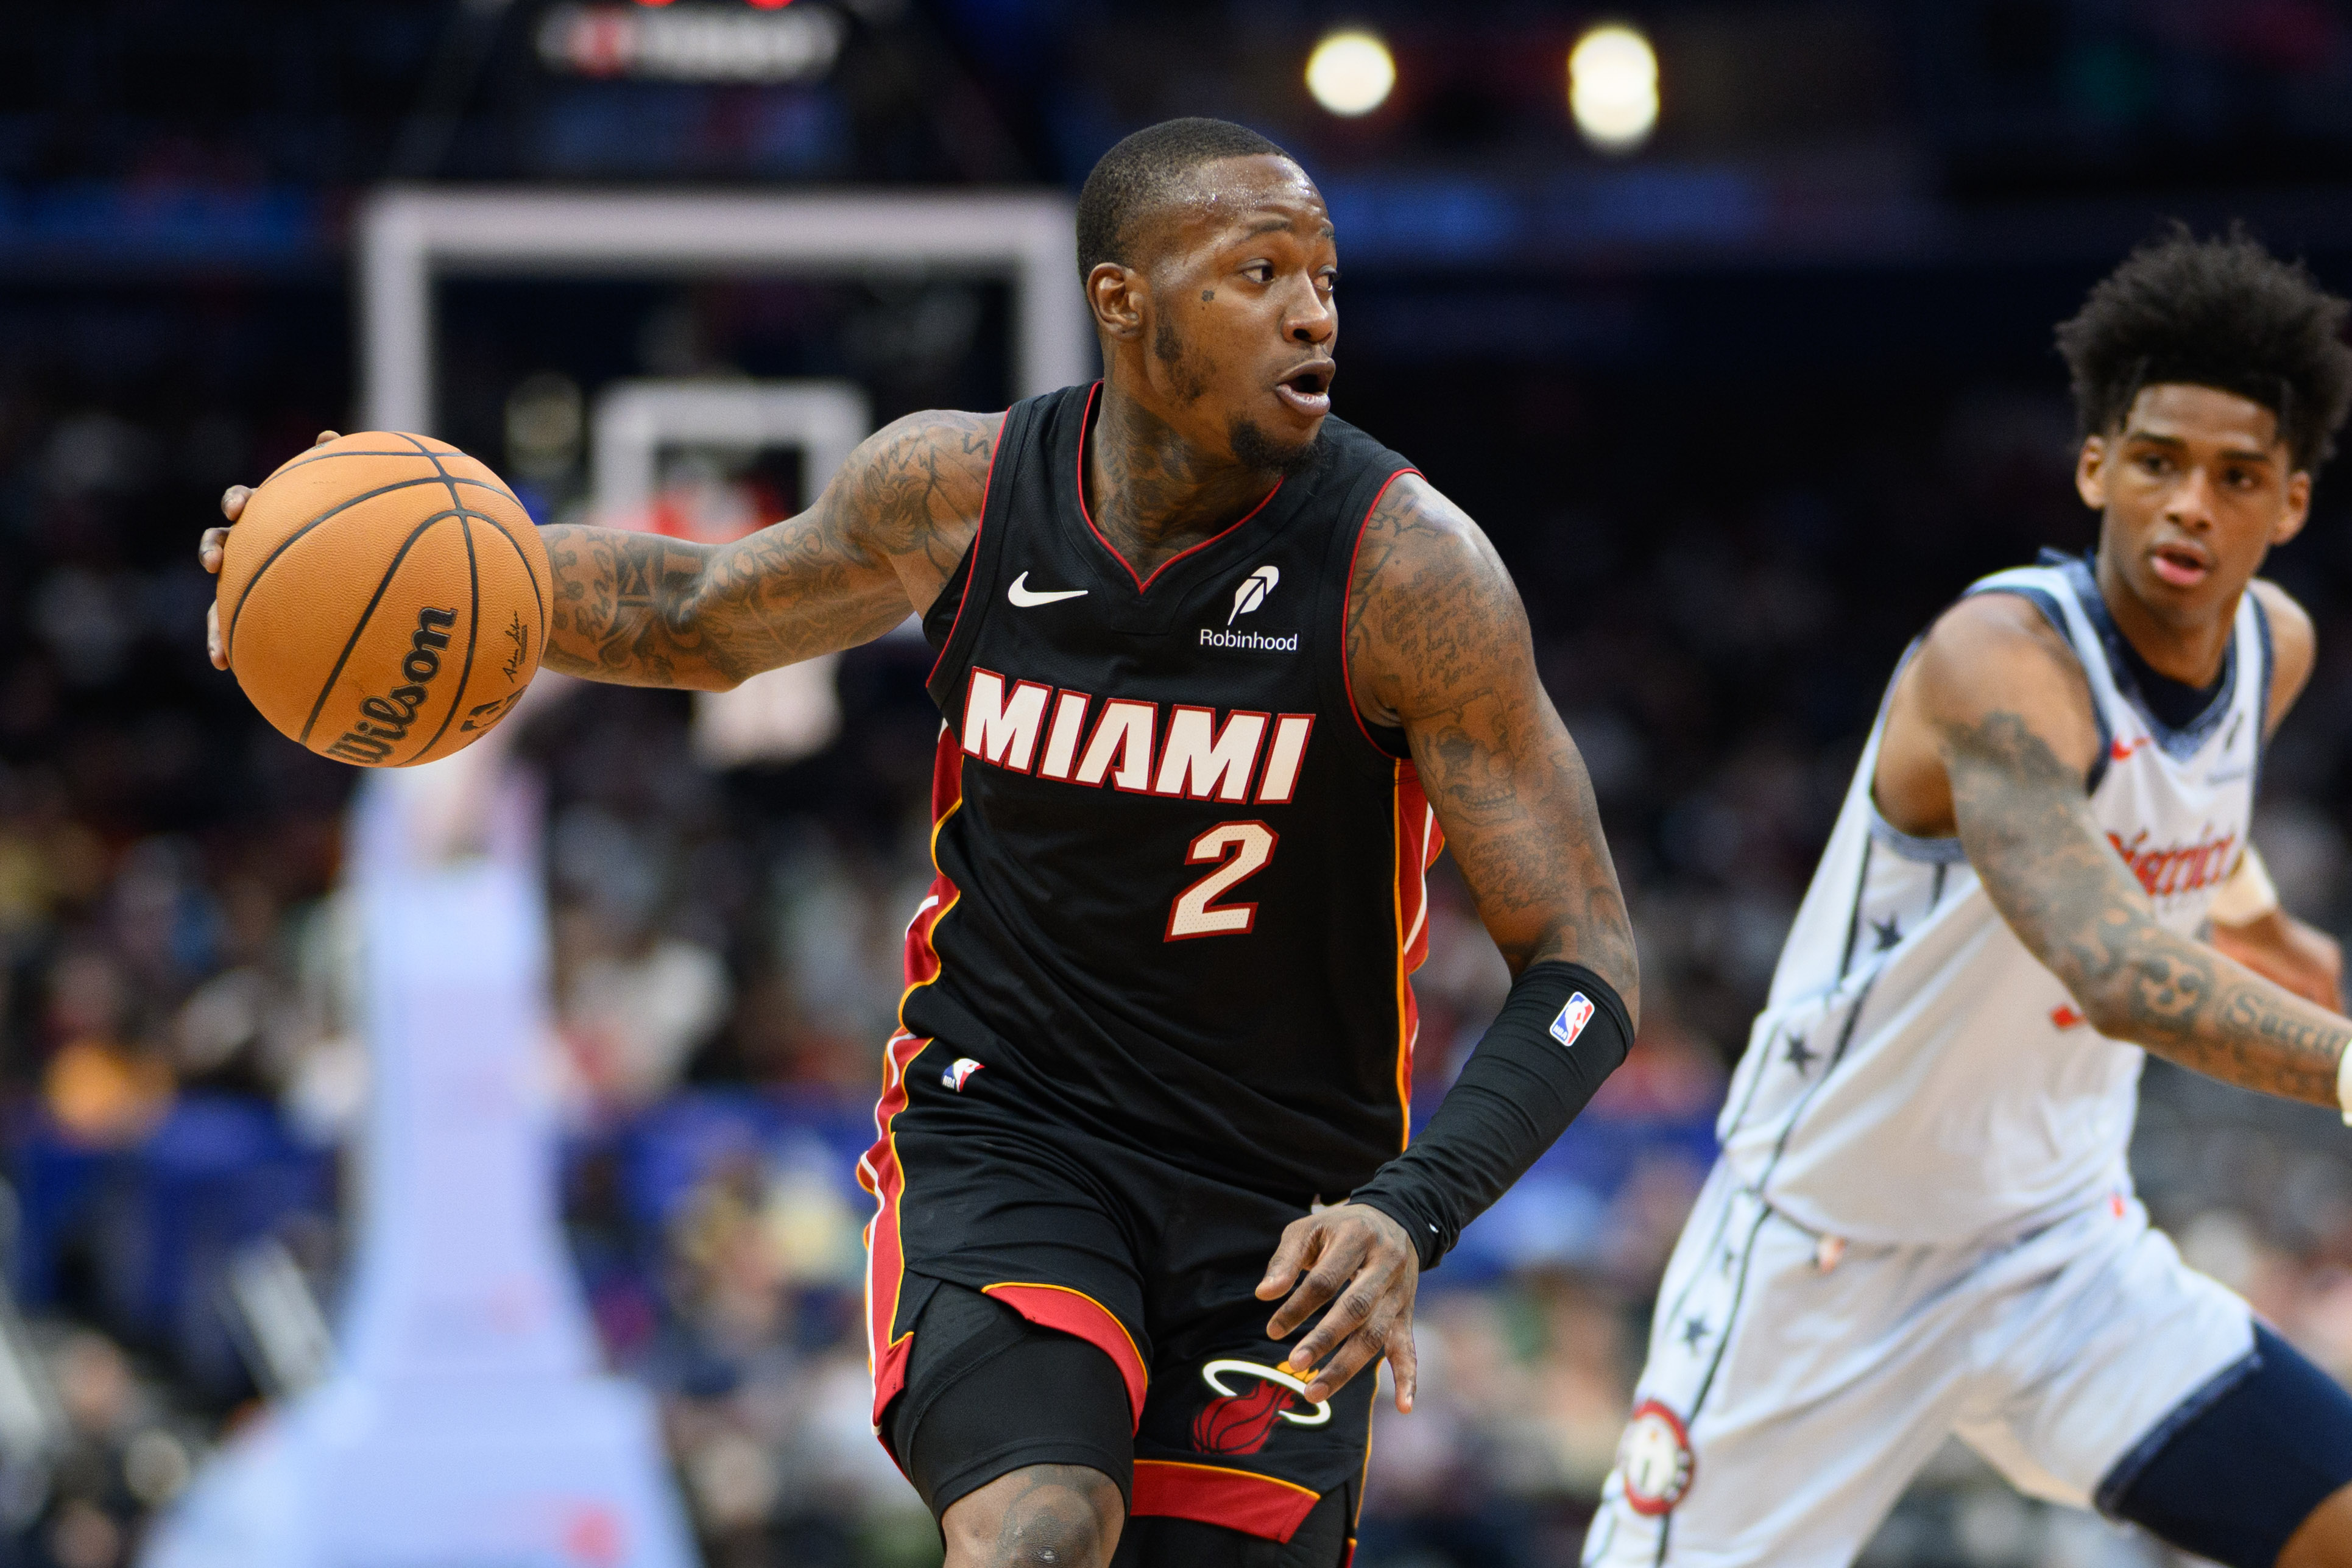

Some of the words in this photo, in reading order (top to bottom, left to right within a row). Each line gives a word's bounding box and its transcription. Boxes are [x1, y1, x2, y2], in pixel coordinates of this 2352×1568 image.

[325, 607, 458, 764] Wilson
[1199, 629, 1298, 651] Robinhood
[961, 666, 1316, 805] MIAMI
[1164, 819, 1279, 942] 2
[943, 1075, 955, 1089] NBA
